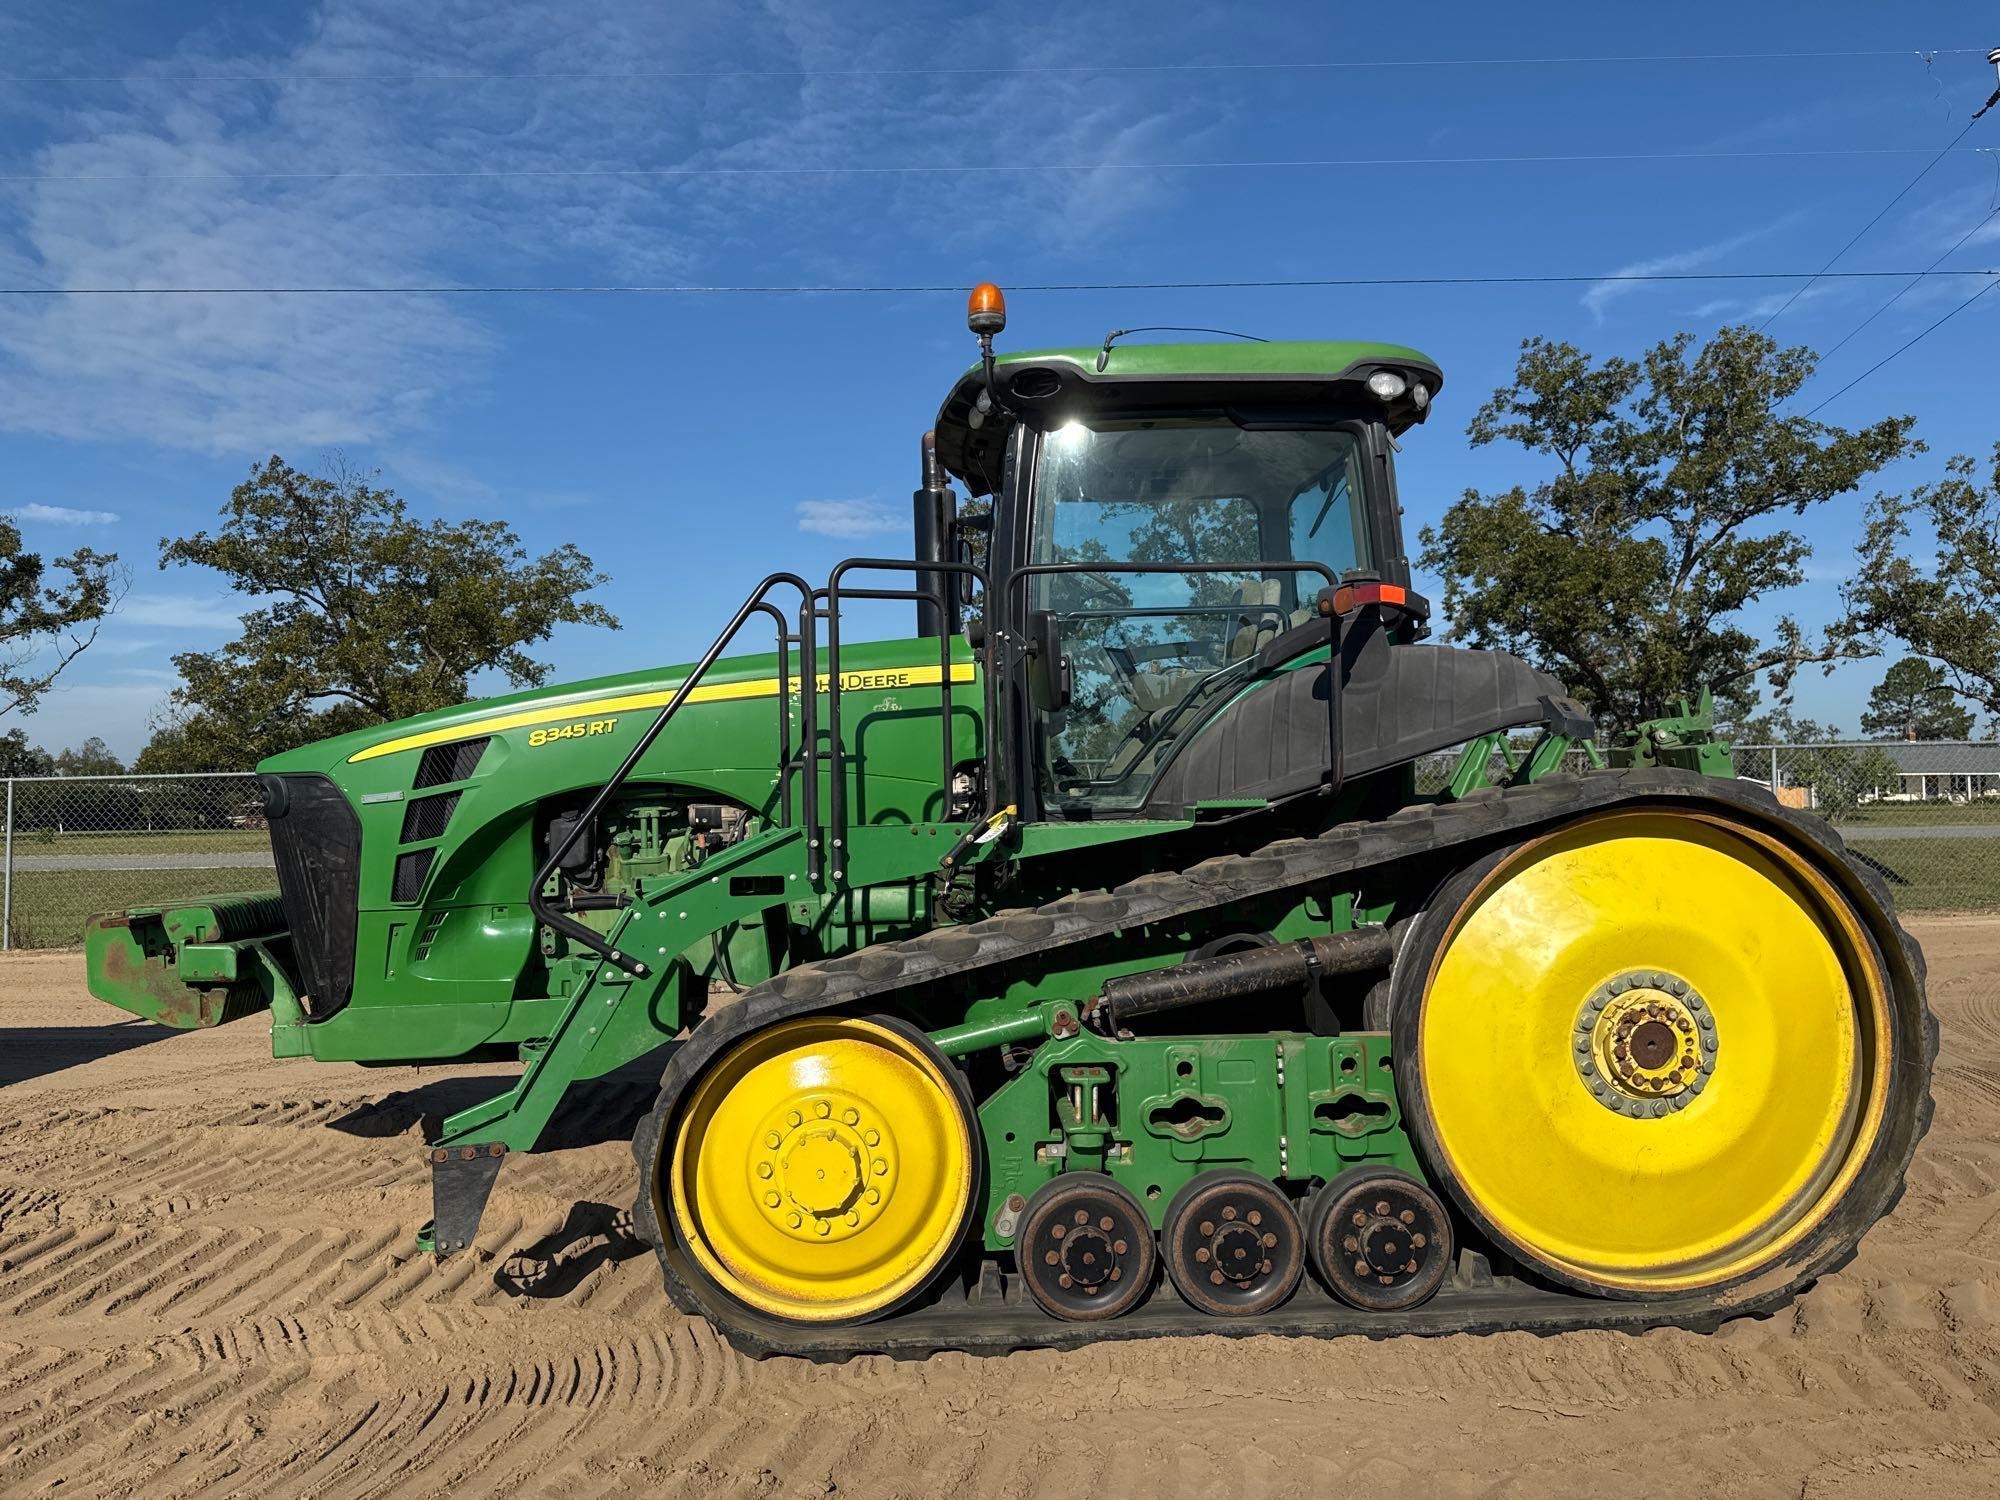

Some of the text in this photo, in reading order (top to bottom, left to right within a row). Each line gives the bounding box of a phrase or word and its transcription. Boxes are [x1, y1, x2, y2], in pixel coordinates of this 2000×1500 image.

[848, 673, 909, 689] DEERE
[528, 718, 618, 747] 8345 RT
